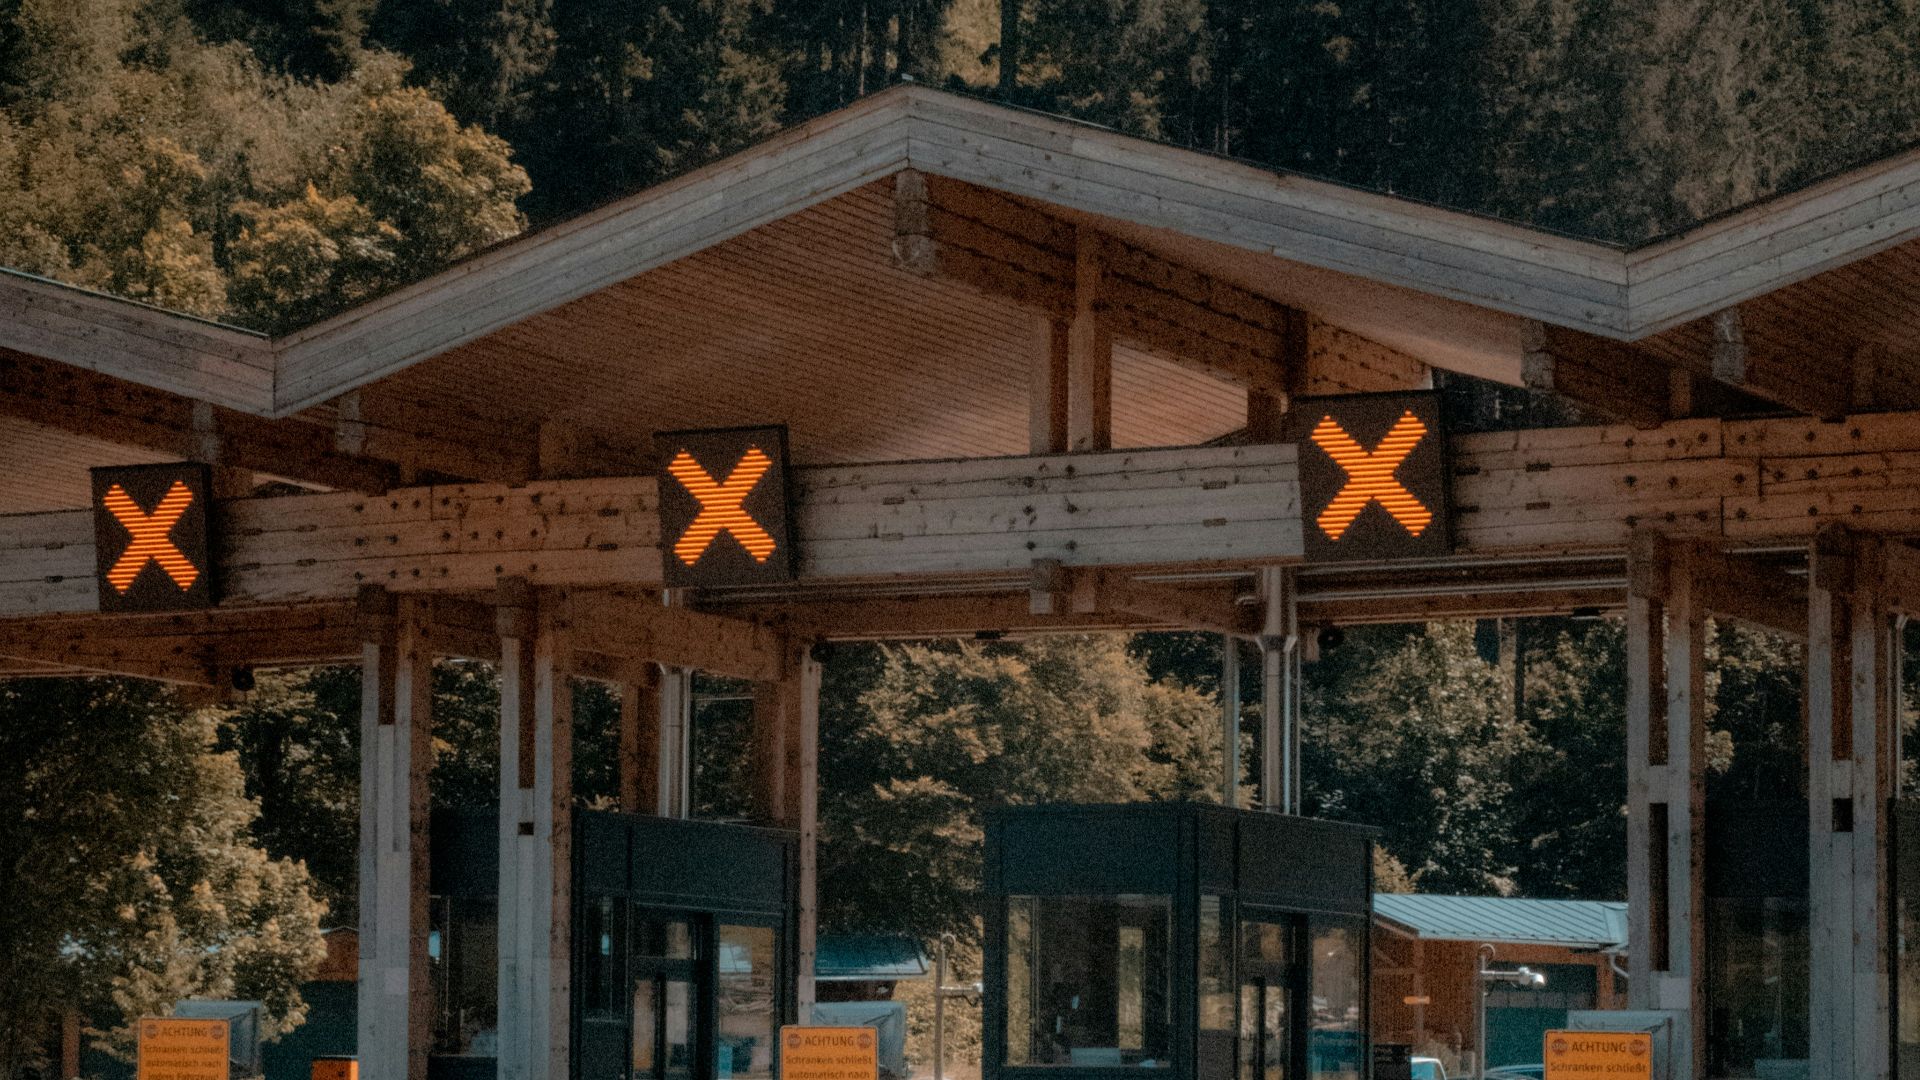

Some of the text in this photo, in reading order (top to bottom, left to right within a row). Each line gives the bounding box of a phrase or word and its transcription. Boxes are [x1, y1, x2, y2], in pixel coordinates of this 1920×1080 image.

[161, 1026, 208, 1037] ACHTUNG
[804, 1035, 854, 1047] ACHTUNG
[144, 1044, 188, 1054] Schranken
[1571, 1041, 1626, 1053] ACHTUNG
[145, 1059, 222, 1068] automatisch nach
[786, 1055, 872, 1065] Schranken schließt
[1550, 1062, 1647, 1073] Schranken schließt
[789, 1070, 870, 1079] automatisch nach
